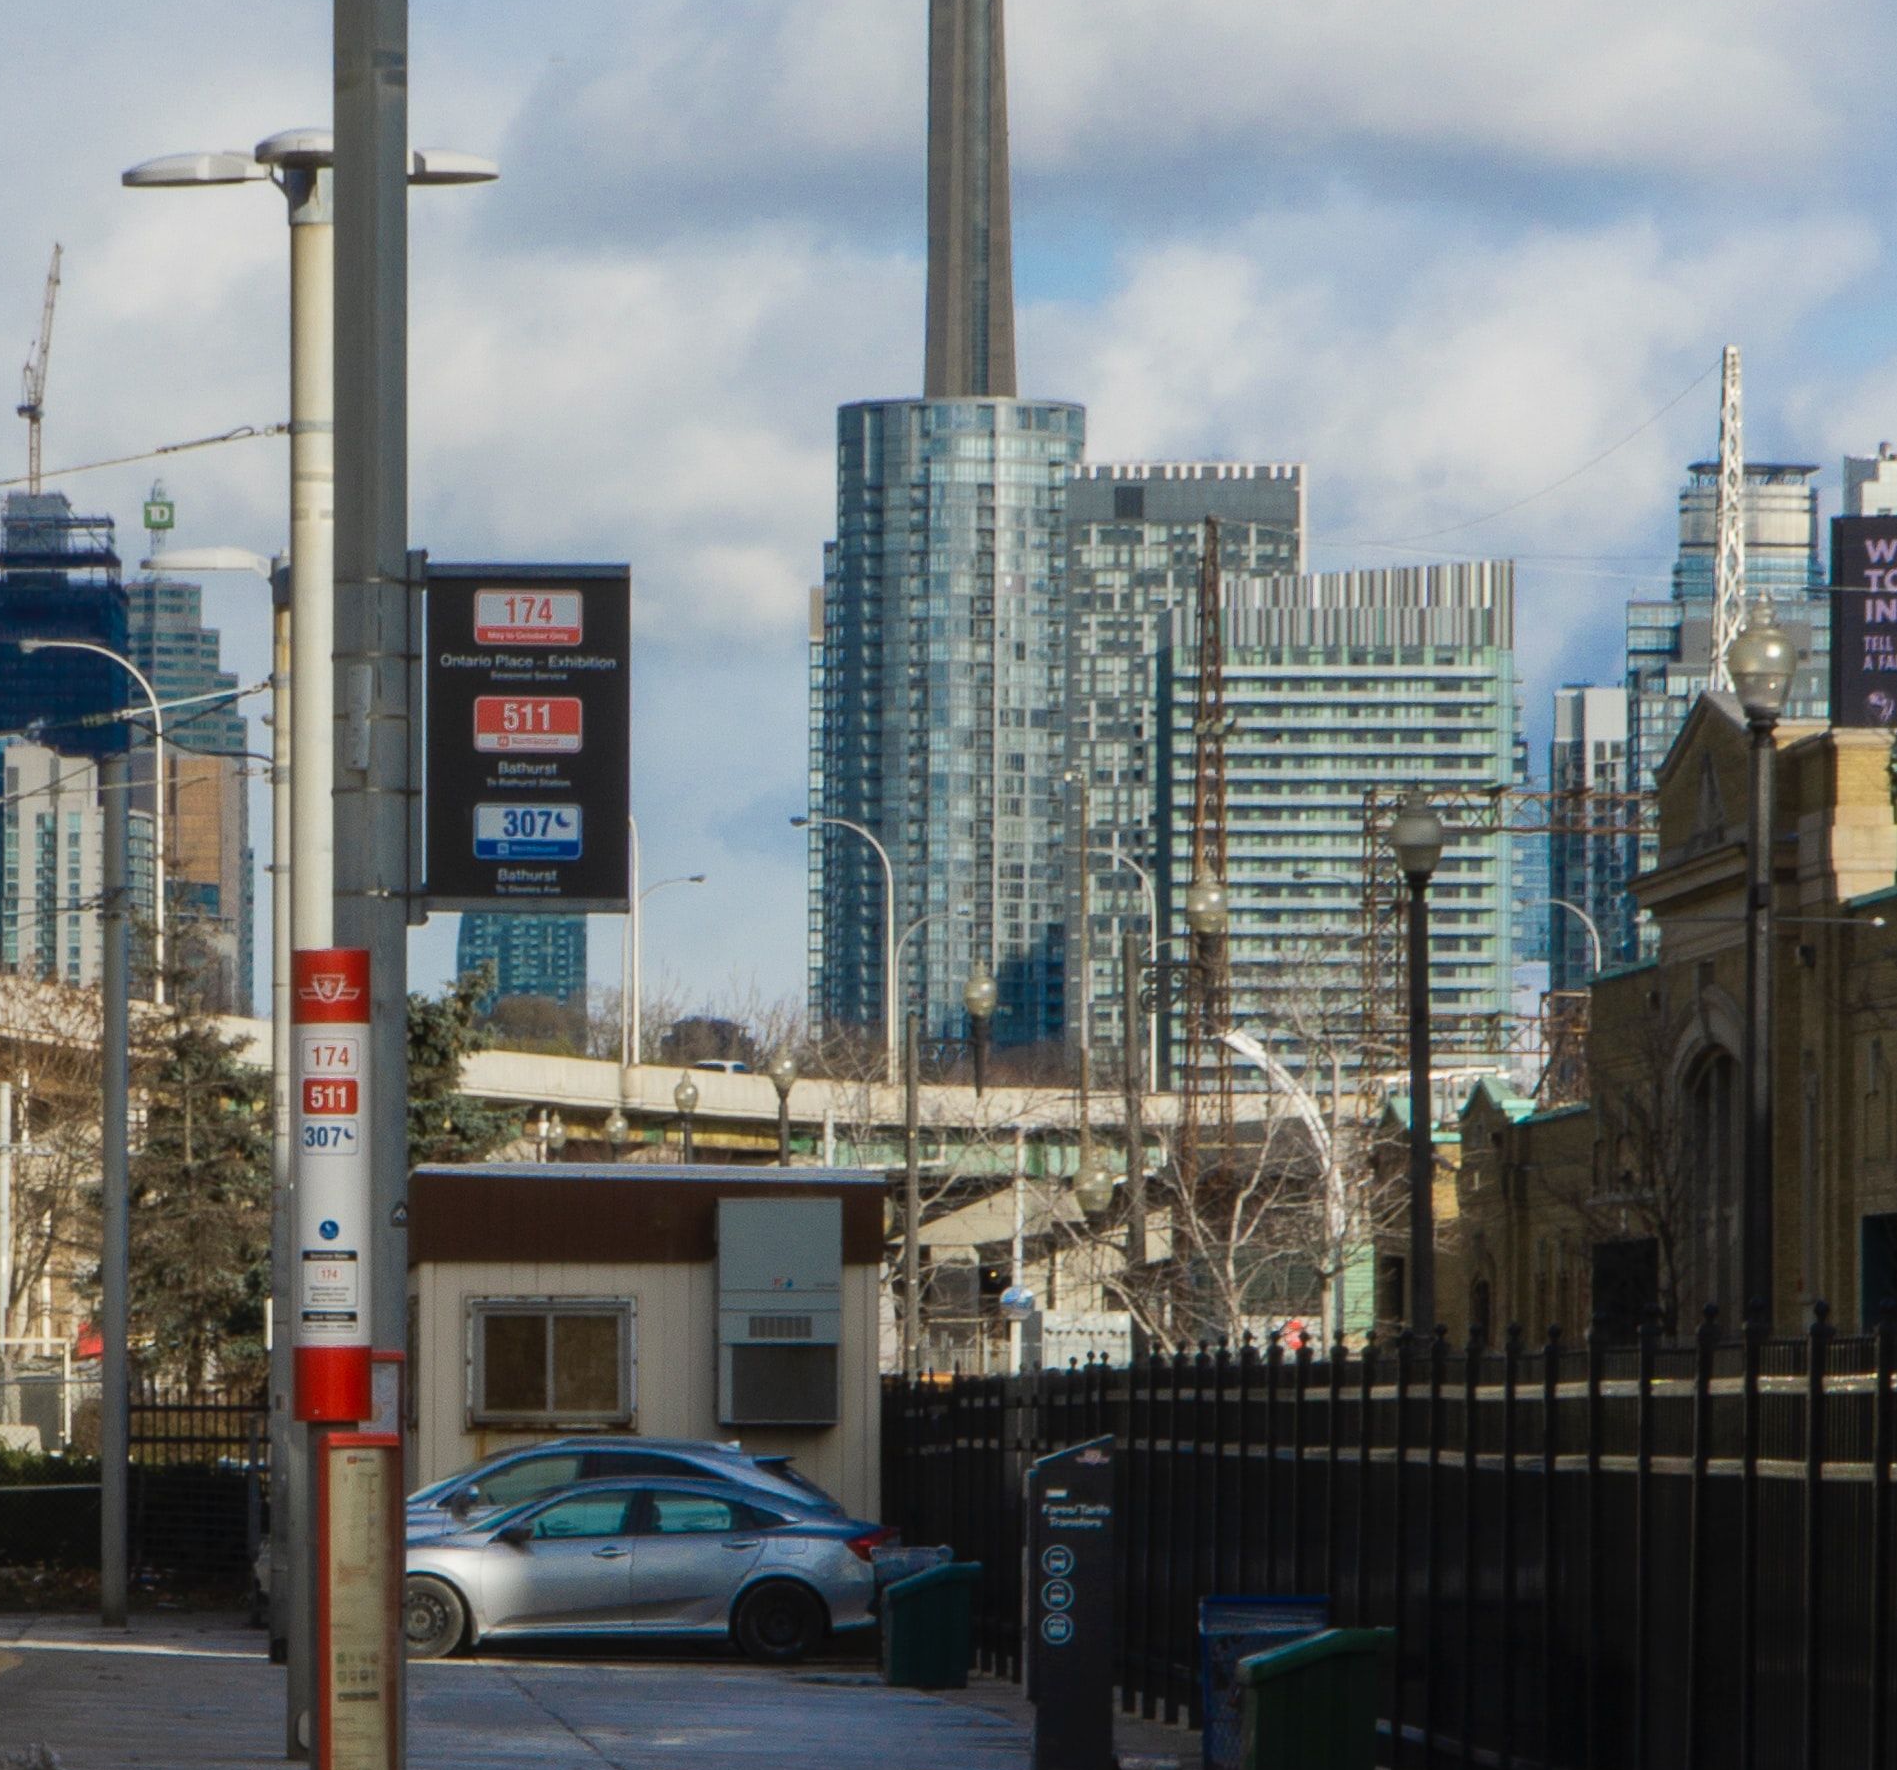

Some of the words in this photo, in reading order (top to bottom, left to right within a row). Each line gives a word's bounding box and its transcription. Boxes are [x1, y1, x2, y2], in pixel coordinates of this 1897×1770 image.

[145, 505, 169, 521] TD
[505, 597, 553, 623] 174
[1864, 635, 1893, 652] TELL
[440, 653, 491, 669] Ontario
[496, 654, 533, 669] Place
[548, 655, 616, 670] Exhibition
[1864, 654, 1873, 670] A
[504, 703, 551, 730] 511
[498, 761, 557, 775] Bathurst
[504, 810, 552, 837] 307
[497, 868, 557, 882] Bathurst
[312, 1045, 349, 1067] 174
[310, 1085, 348, 1109] 511
[304, 1125, 342, 1148] 307
